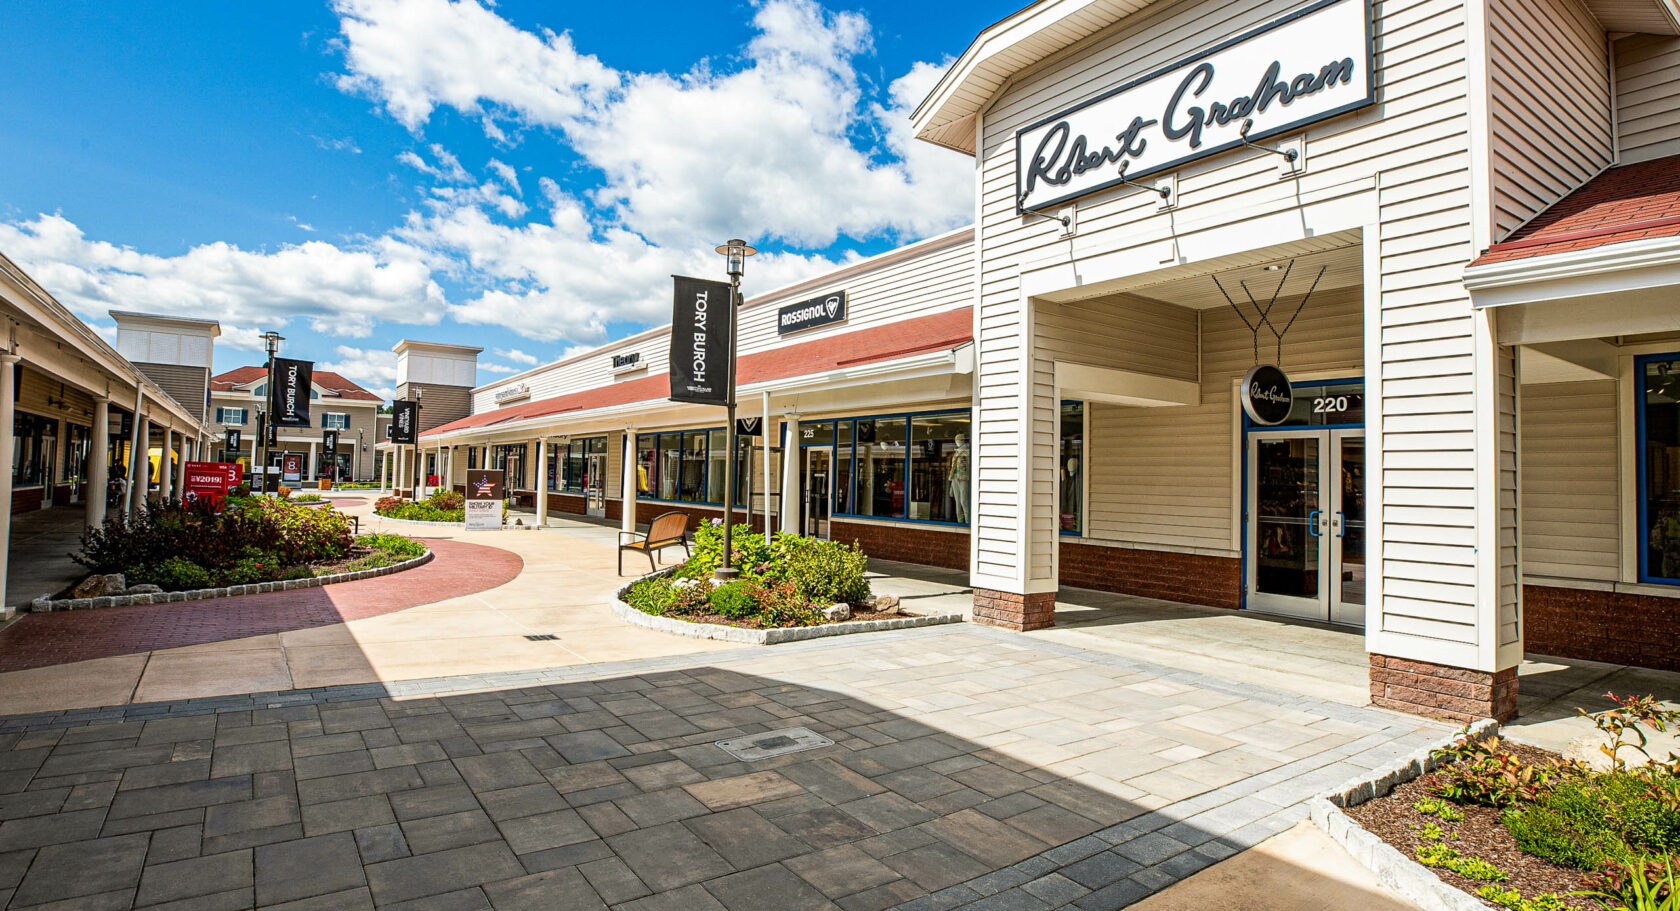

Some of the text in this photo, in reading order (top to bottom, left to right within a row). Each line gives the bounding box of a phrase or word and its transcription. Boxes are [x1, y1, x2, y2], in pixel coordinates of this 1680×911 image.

[1027, 57, 1354, 192] Robert Graham
[695, 291, 708, 331] TORY
[781, 303, 826, 326] ROSSIGNOL
[611, 353, 640, 369] Theory
[693, 333, 706, 382] BURCH
[288, 365, 297, 387] TORY
[286, 388, 295, 416] BURCH
[1313, 396, 1348, 413] 220
[803, 429, 815, 439] 225
